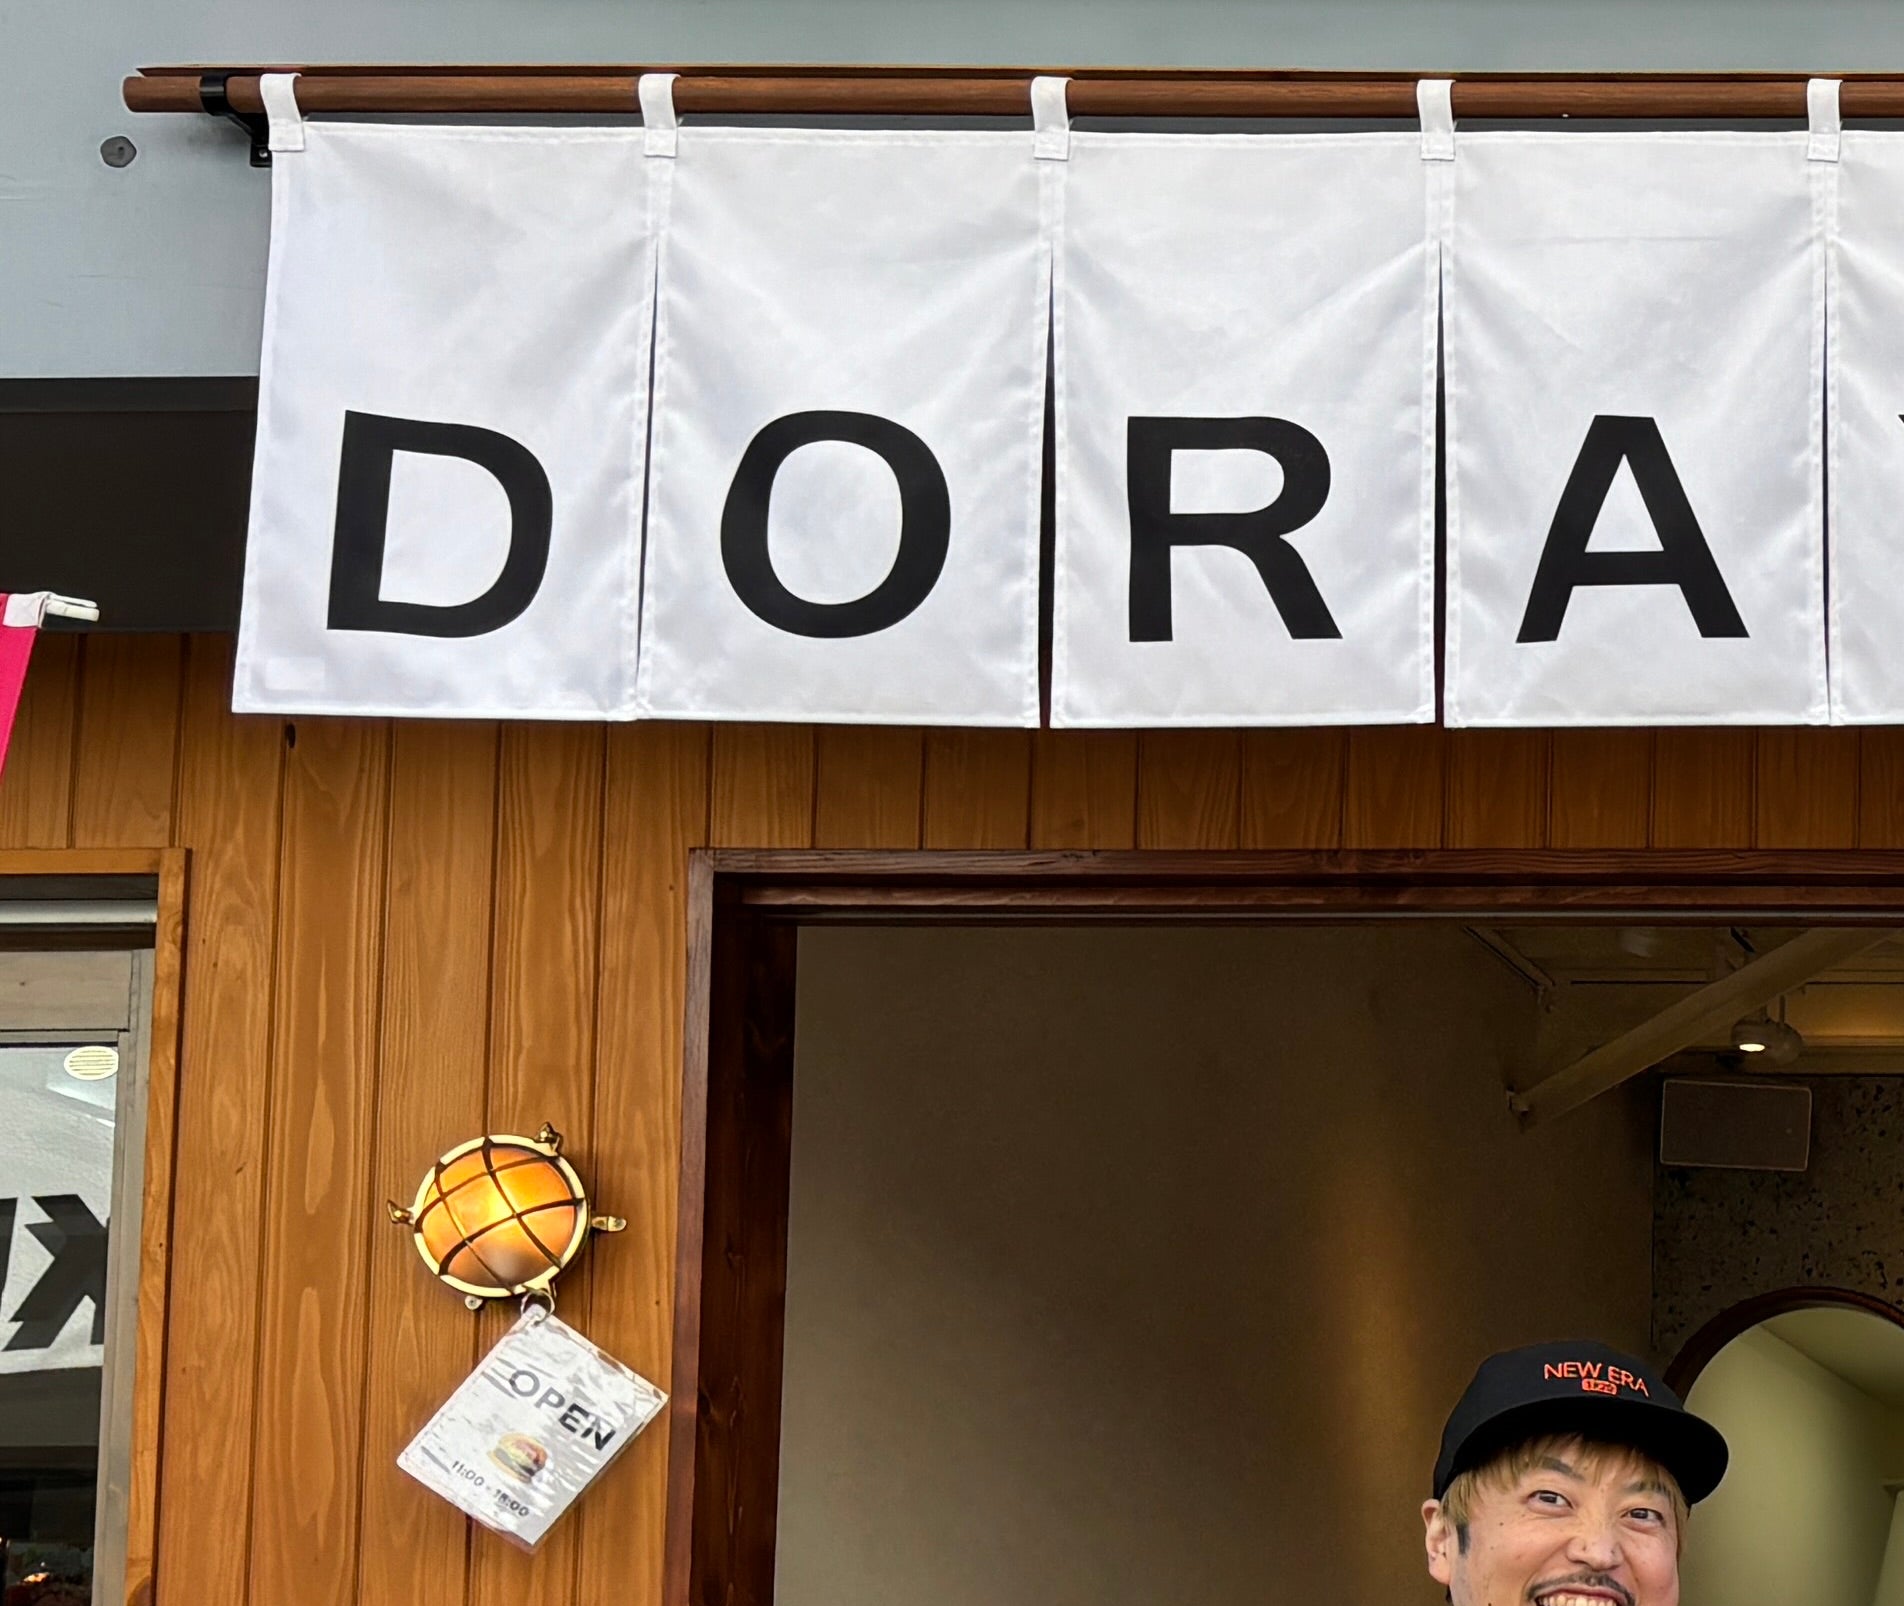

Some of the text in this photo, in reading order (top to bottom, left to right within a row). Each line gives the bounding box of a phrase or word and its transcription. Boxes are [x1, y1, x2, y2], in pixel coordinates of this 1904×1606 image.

[1544, 1361, 1649, 1397] NEW ERA
[508, 1369, 616, 1451] OPEN
[452, 1460, 485, 1487] 11:00
